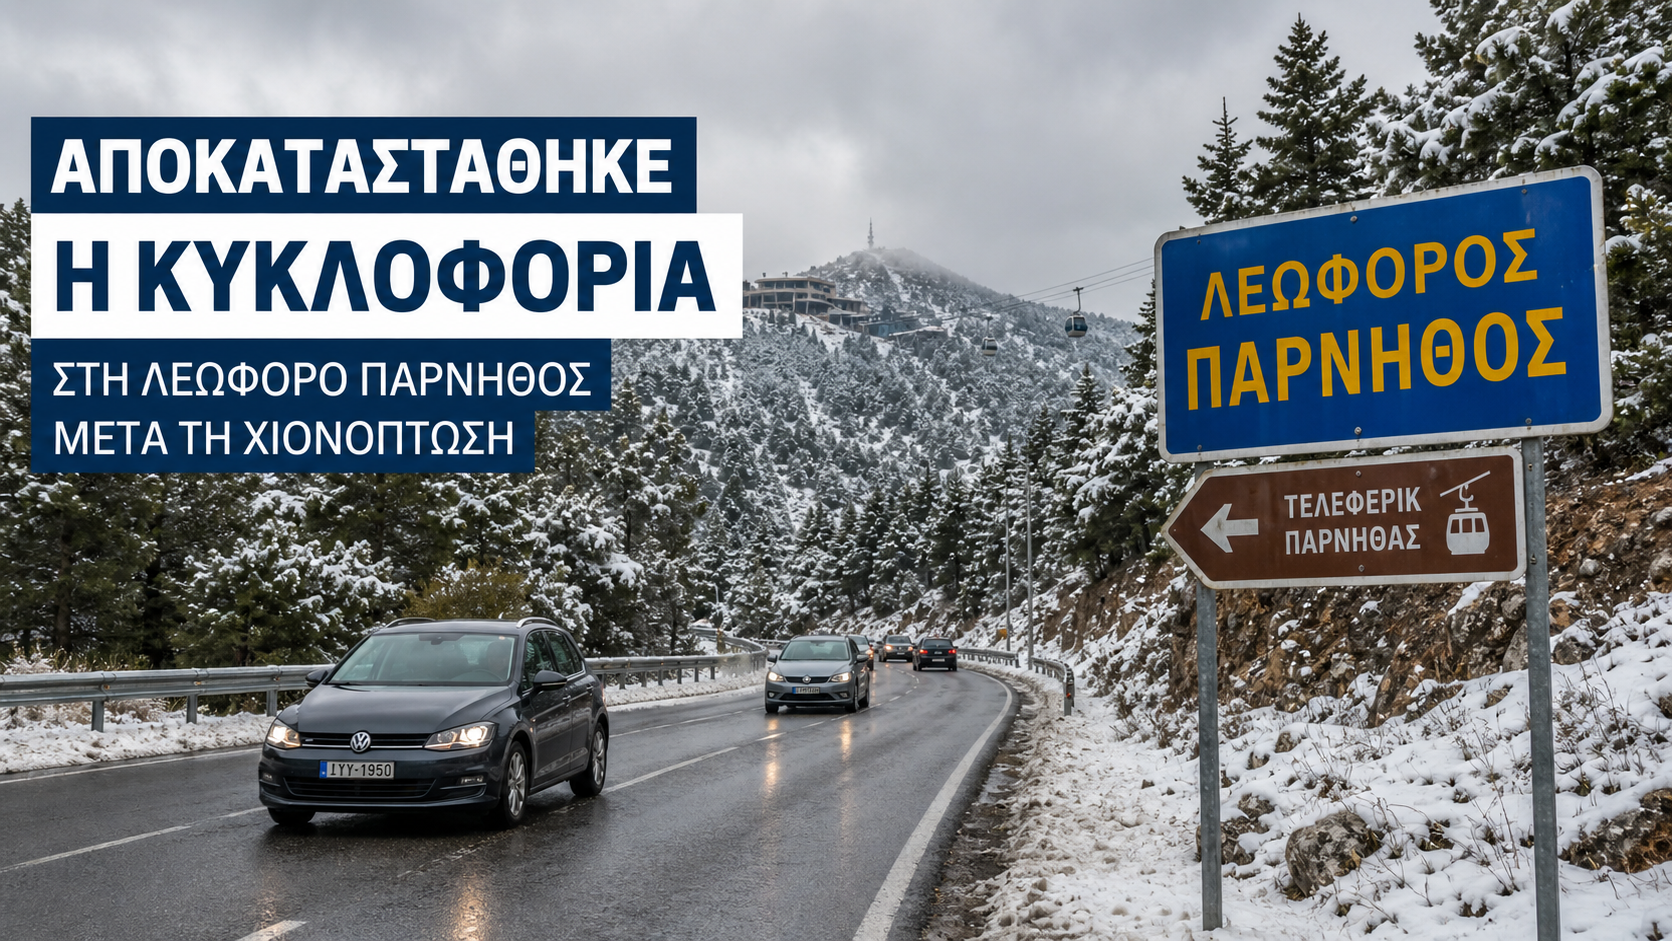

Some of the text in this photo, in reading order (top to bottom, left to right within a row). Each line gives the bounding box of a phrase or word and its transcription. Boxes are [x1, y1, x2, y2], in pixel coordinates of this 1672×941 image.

[1200, 228, 1538, 321] ΛΕΩΦΟΡΟΣ
[1187, 307, 1567, 411] ΠΑΡΝΗΘΟΣ
[1284, 487, 1422, 519] ΤΕΛΕΦΕΡΙΚ
[1285, 524, 1421, 555] ΠΑΡΝΗΘΑΣ
